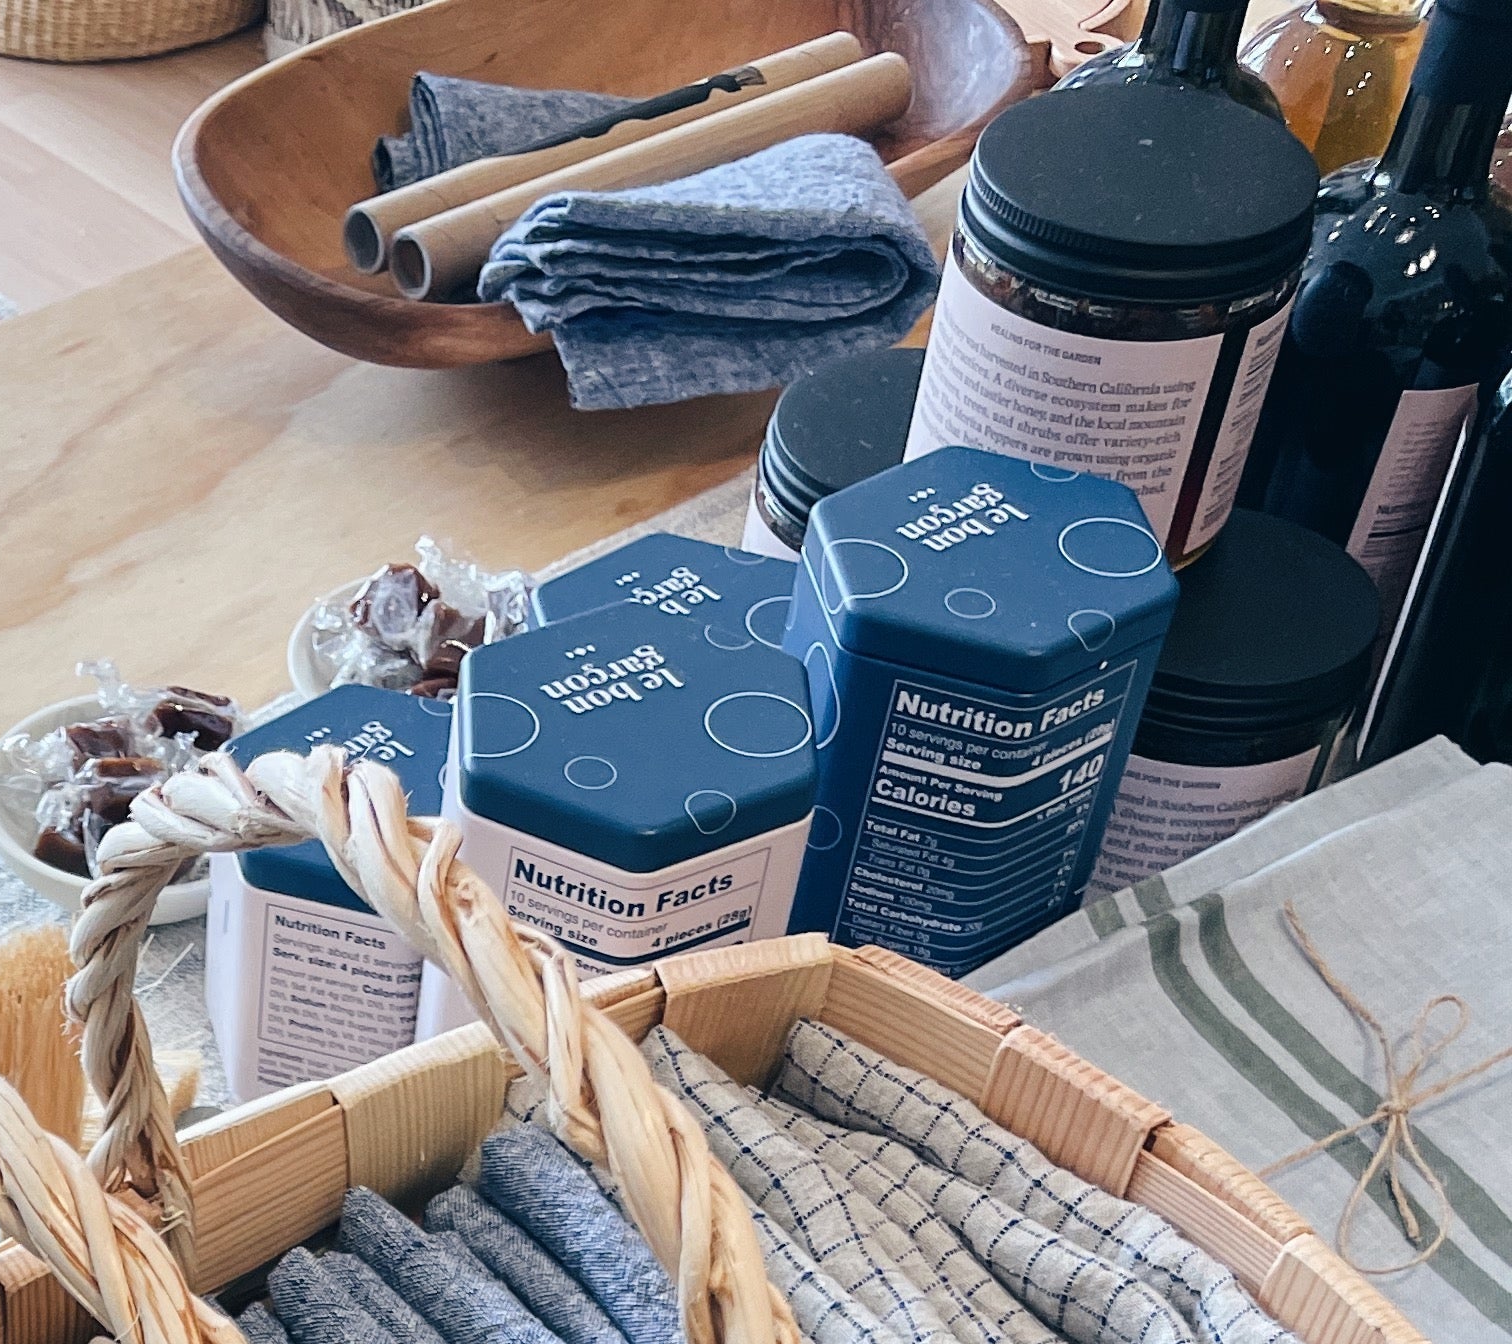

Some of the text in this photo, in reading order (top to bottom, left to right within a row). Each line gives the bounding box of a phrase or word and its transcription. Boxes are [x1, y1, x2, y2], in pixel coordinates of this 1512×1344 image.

[1043, 345, 1061, 359] THE
[1061, 350, 1101, 365] GARDEN
[1004, 377, 1048, 401] diverse
[1051, 391, 1121, 412] ecosystem
[1125, 401, 1168, 413] makes
[1172, 397, 1192, 411] for
[1042, 372, 1096, 393] Southern
[1100, 381, 1160, 396] California
[992, 407, 1013, 428] and
[1017, 420, 1061, 442] shrubs
[1065, 429, 1098, 445] offer
[1103, 431, 1181, 448] variety-rich
[1049, 408, 1073, 426] and
[1075, 413, 1095, 430] the
[1030, 442, 1051, 458] are
[1053, 449, 1093, 467] grown
[1115, 467, 1148, 482] from
[896, 483, 1004, 540] garçon
[921, 503, 1030, 551] le bon
[631, 566, 700, 605] garç
[681, 584, 722, 605] le
[539, 645, 665, 699] garçon
[560, 668, 685, 714] le bon
[896, 688, 1105, 738] Nutrition Facts
[885, 736, 946, 765] Serving
[949, 754, 981, 770] size
[891, 722, 906, 737] 10
[908, 728, 963, 752] servings
[966, 743, 989, 757] per
[875, 754, 1104, 817] Calories 140
[878, 763, 1003, 803] Amount Per Serving
[866, 820, 897, 837] Total
[900, 828, 920, 842] Fat
[514, 858, 733, 917] Nutrition Facts
[851, 882, 894, 901] Sodium
[854, 866, 923, 892] Cholesterol
[508, 904, 563, 936] Serving
[568, 928, 598, 947] size
[652, 937, 660, 948] 4
[665, 920, 713, 947] pieces
[510, 889, 668, 939] 10 servings per container
[847, 897, 961, 932] Total Carbohydrate
[275, 915, 386, 950] Nutrition Facts
[272, 947, 392, 982] Serv. size: 4 pieces
[327, 947, 360, 963] about
[363, 953, 370, 963] 5
